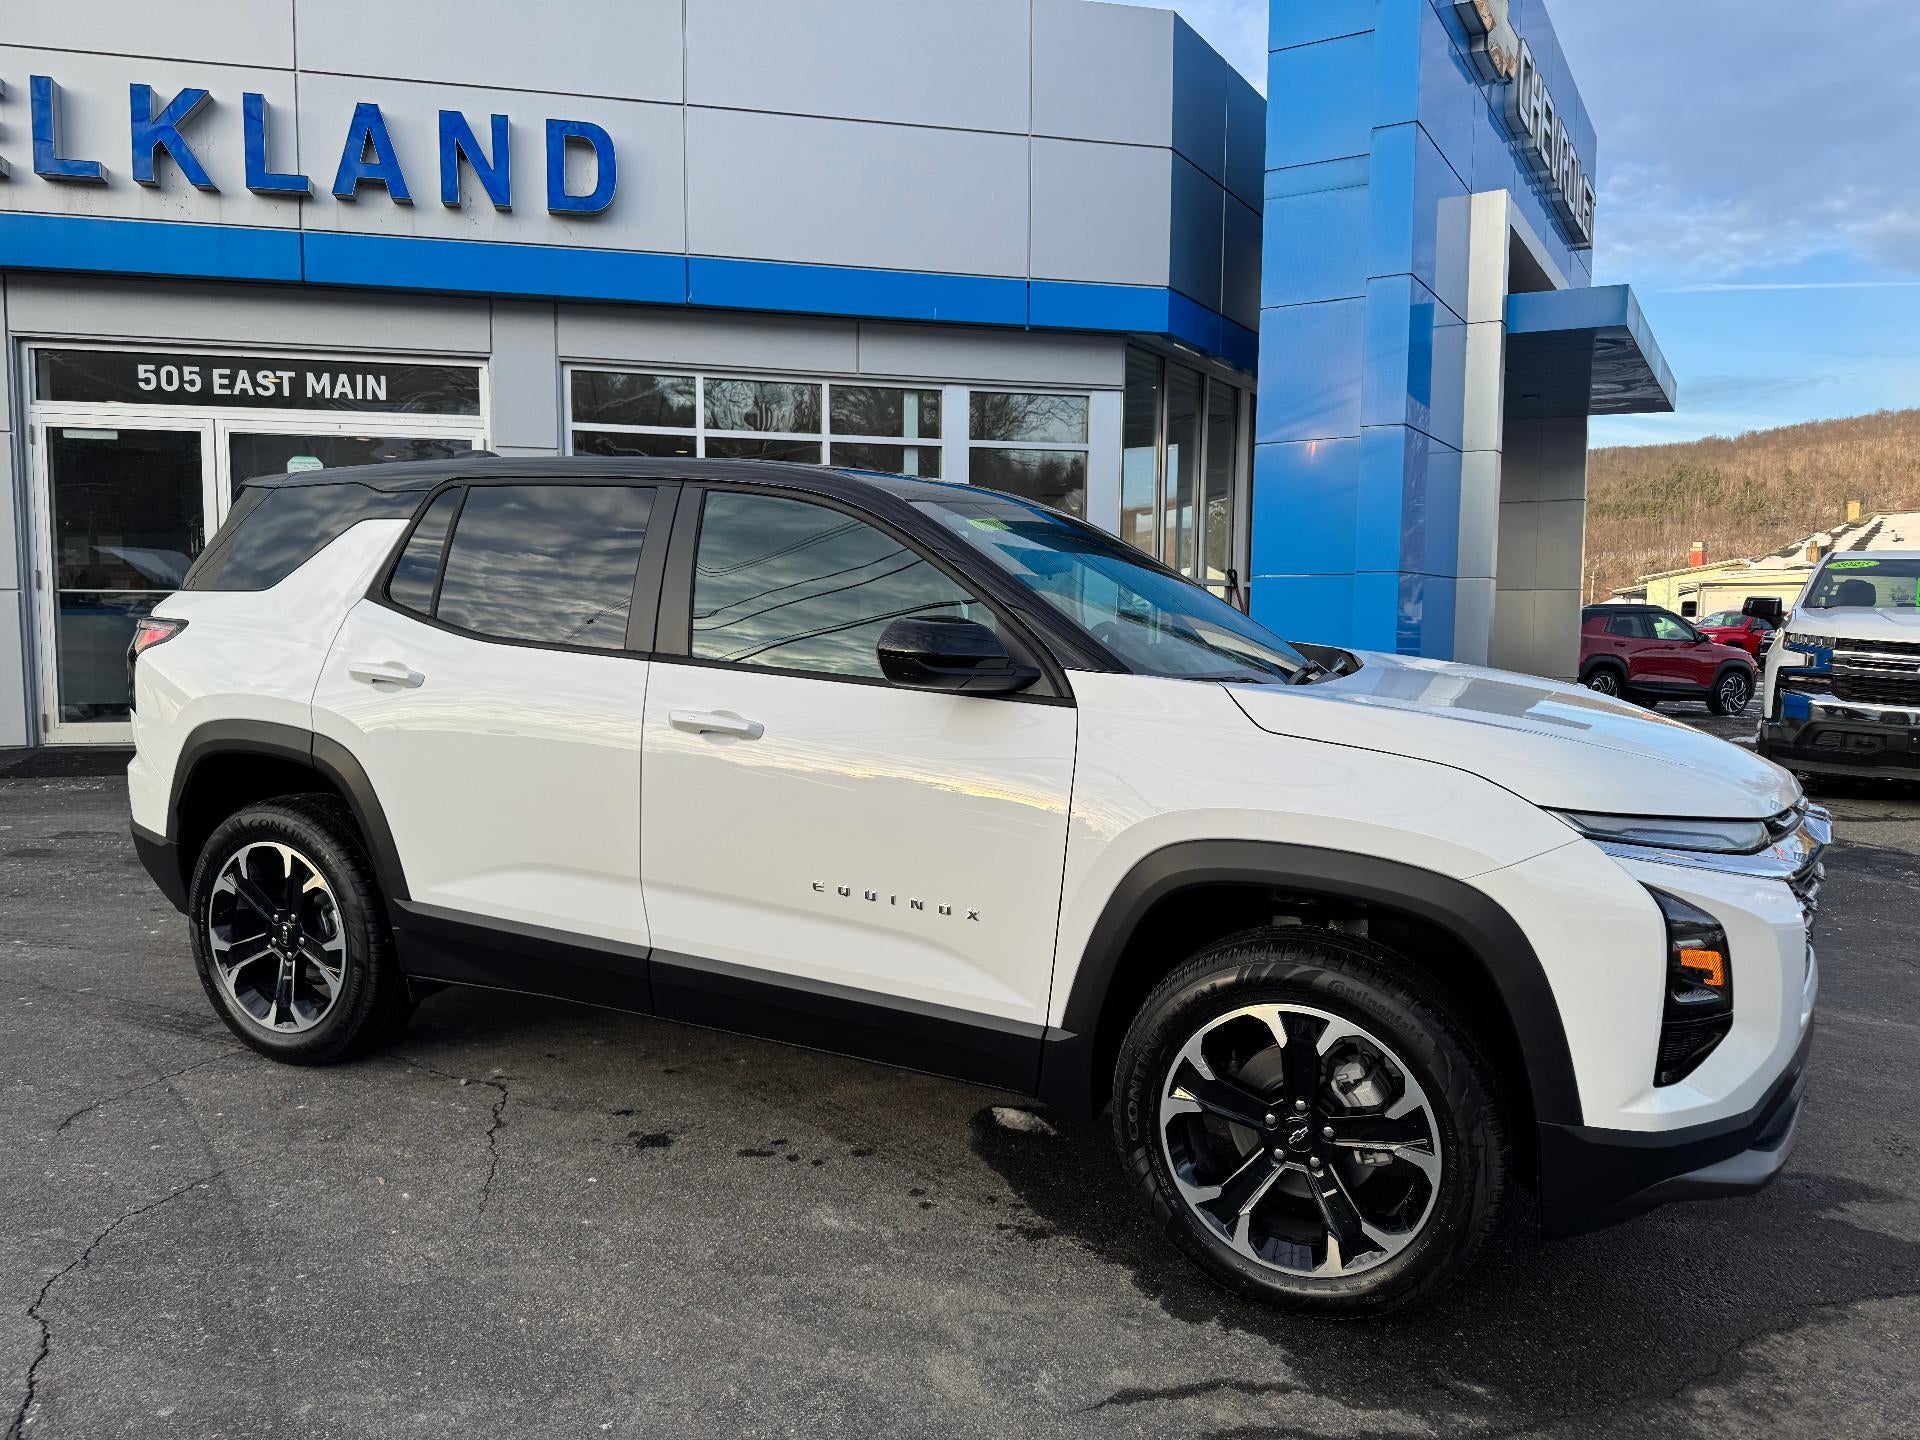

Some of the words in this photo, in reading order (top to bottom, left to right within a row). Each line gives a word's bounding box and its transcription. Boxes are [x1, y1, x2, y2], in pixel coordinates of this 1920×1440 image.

[0, 75, 618, 217] LKLAND
[137, 364, 202, 393] 505
[212, 368, 296, 397] EAST
[306, 372, 388, 401] MAIN
[811, 879, 981, 922] EQUINOX
